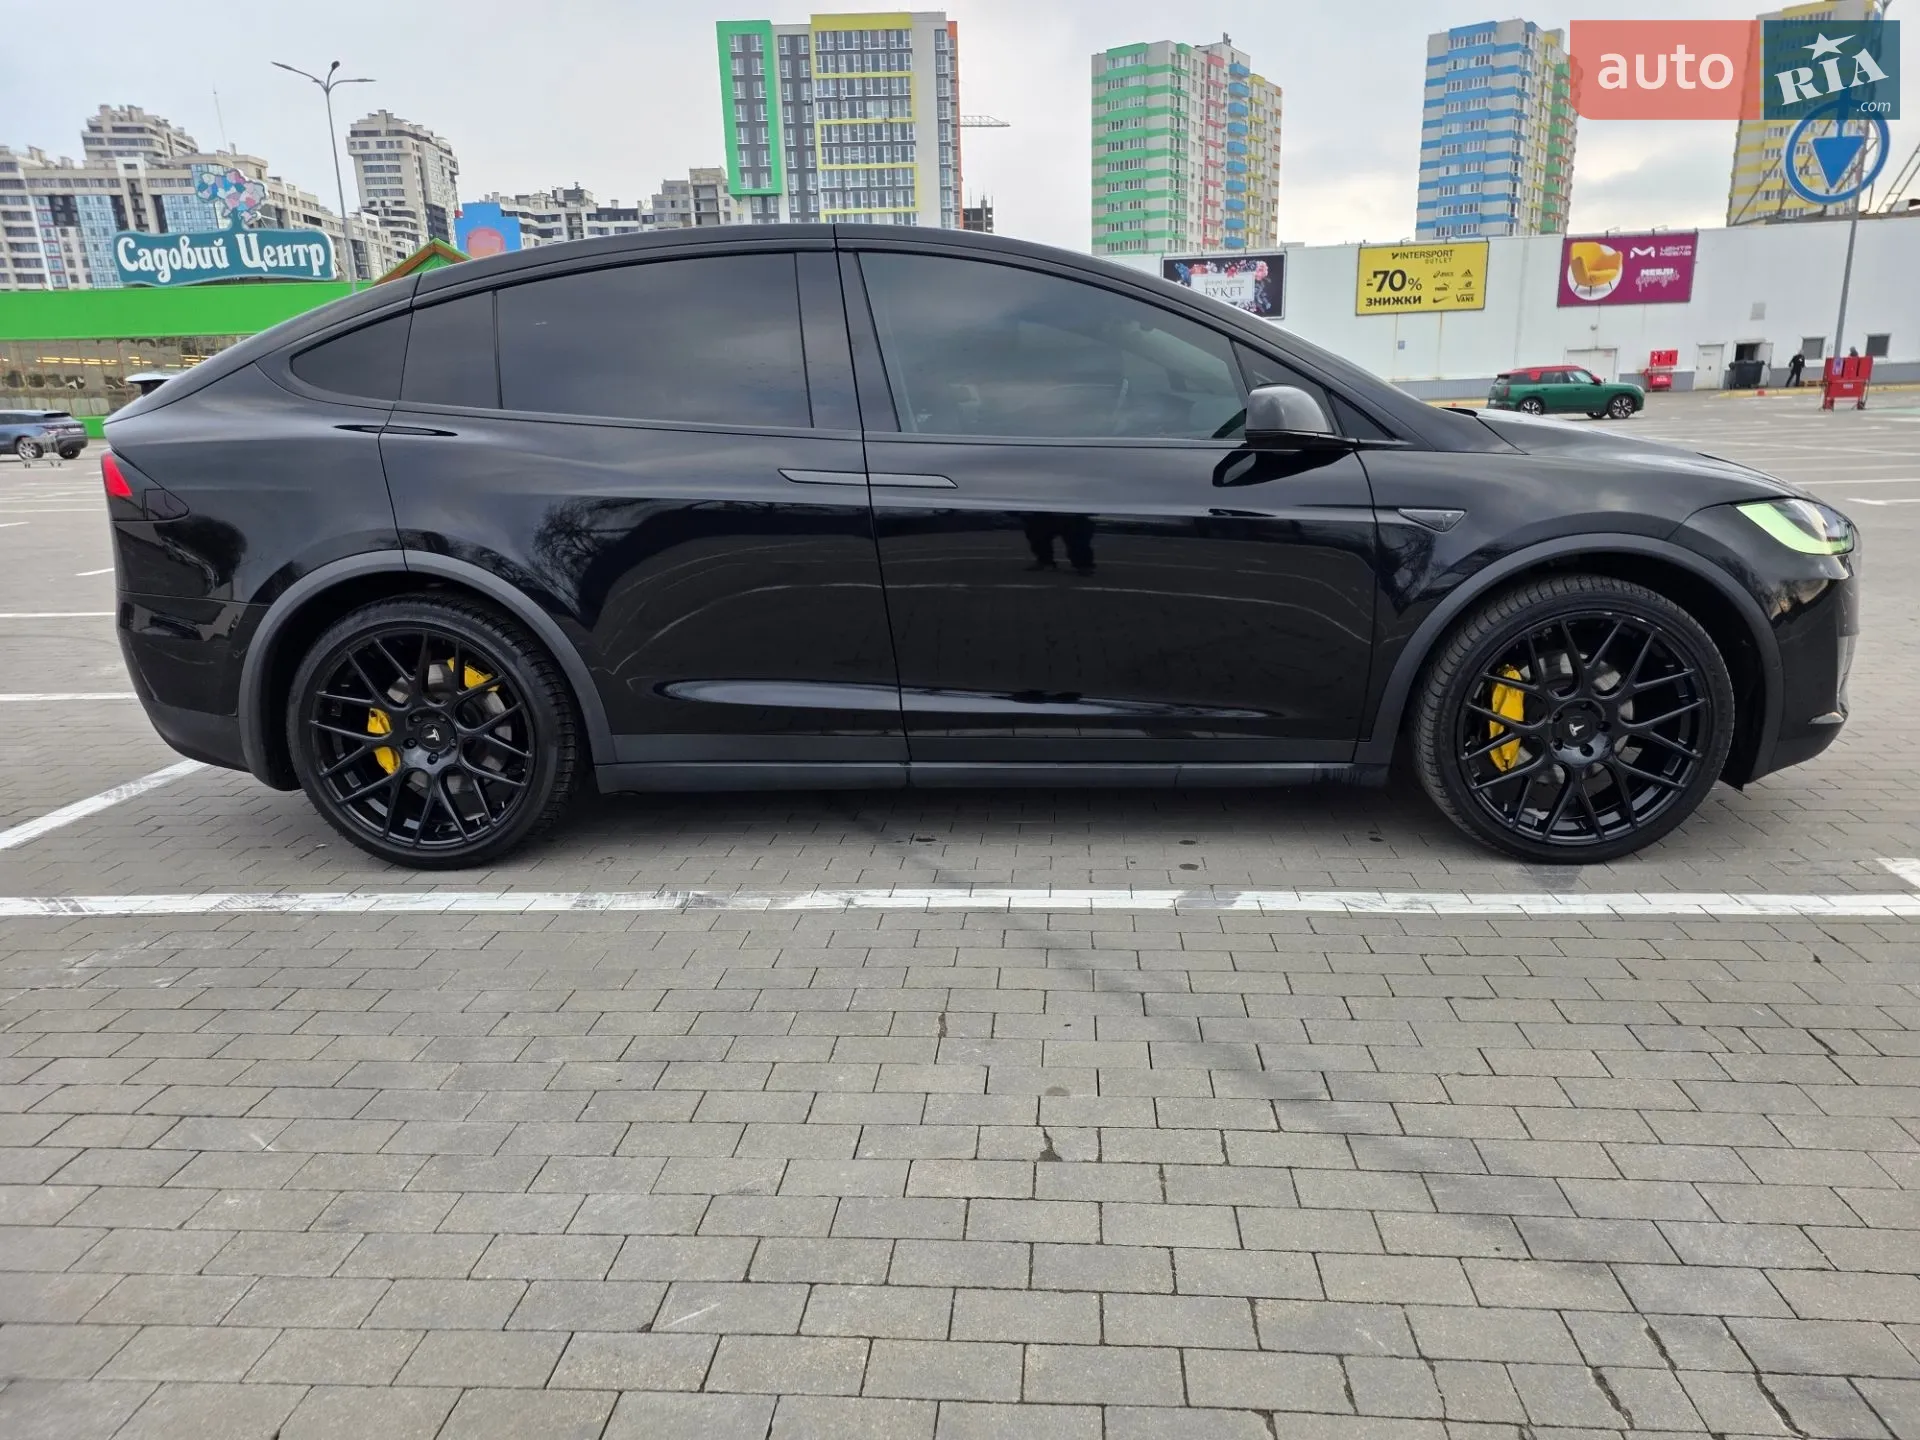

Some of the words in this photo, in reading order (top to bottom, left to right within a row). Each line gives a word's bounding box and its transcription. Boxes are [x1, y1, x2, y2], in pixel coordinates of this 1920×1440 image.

[117, 235, 230, 283] Садовий
[235, 233, 325, 276] Центр
[1400, 249, 1454, 259] INTERSPORT
[1425, 257, 1452, 265] OUTLET
[1366, 269, 1422, 292] -70%
[1205, 286, 1245, 298] БУКЕТ
[1366, 295, 1422, 307] ЗНИЖКИ
